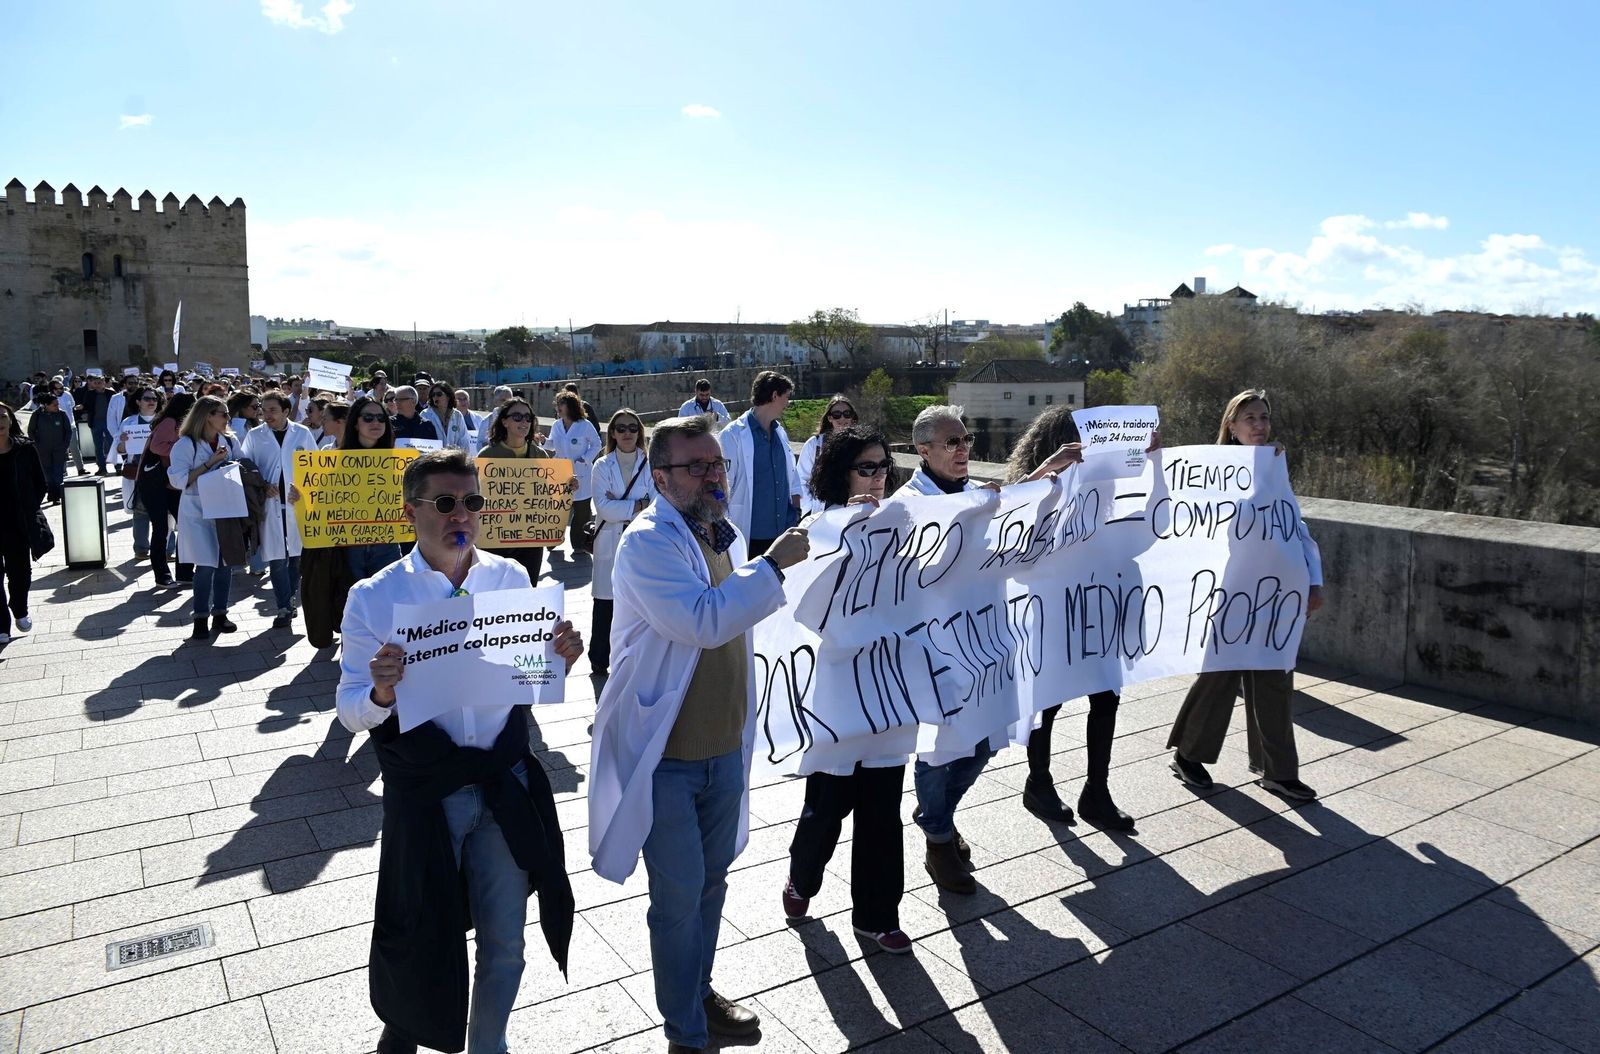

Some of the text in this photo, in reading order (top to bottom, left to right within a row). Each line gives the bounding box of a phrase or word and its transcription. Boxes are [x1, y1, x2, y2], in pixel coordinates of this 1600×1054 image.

[1085, 418, 1157, 432] ¡Mónica, traidora!
[1089, 433, 1148, 447] ¡Stop 24 horas!
[299, 452, 313, 467] SI
[319, 455, 337, 468] UN
[484, 462, 555, 480] CONDUCTOR
[1164, 458, 1252, 491] TIEMPO
[303, 472, 404, 487] AGOTADO ES U
[487, 481, 526, 496] PUEDE
[367, 488, 402, 505] ¿QUÉ
[485, 498, 573, 511] HORAS SEGUIDAS
[305, 510, 321, 521] UN
[326, 507, 369, 521] MÉDICO
[509, 513, 522, 523] UN
[525, 512, 561, 524] MÉDICO
[304, 524, 416, 537] EN UNA GUARDIA DE
[486, 525, 565, 540] ¿TIENE SENTID
[331, 536, 395, 545] 24 HORAS?
[814, 516, 963, 633] TIEMPO
[396, 607, 561, 643] “Médico quemado,
[399, 628, 554, 666] istema colapsado
[853, 631, 920, 734] UN
[905, 594, 1044, 720] ESTATUTO
[1065, 572, 1164, 665] MÉDICO
[1183, 569, 1302, 656] PROPIO
[513, 653, 552, 669] SMA
